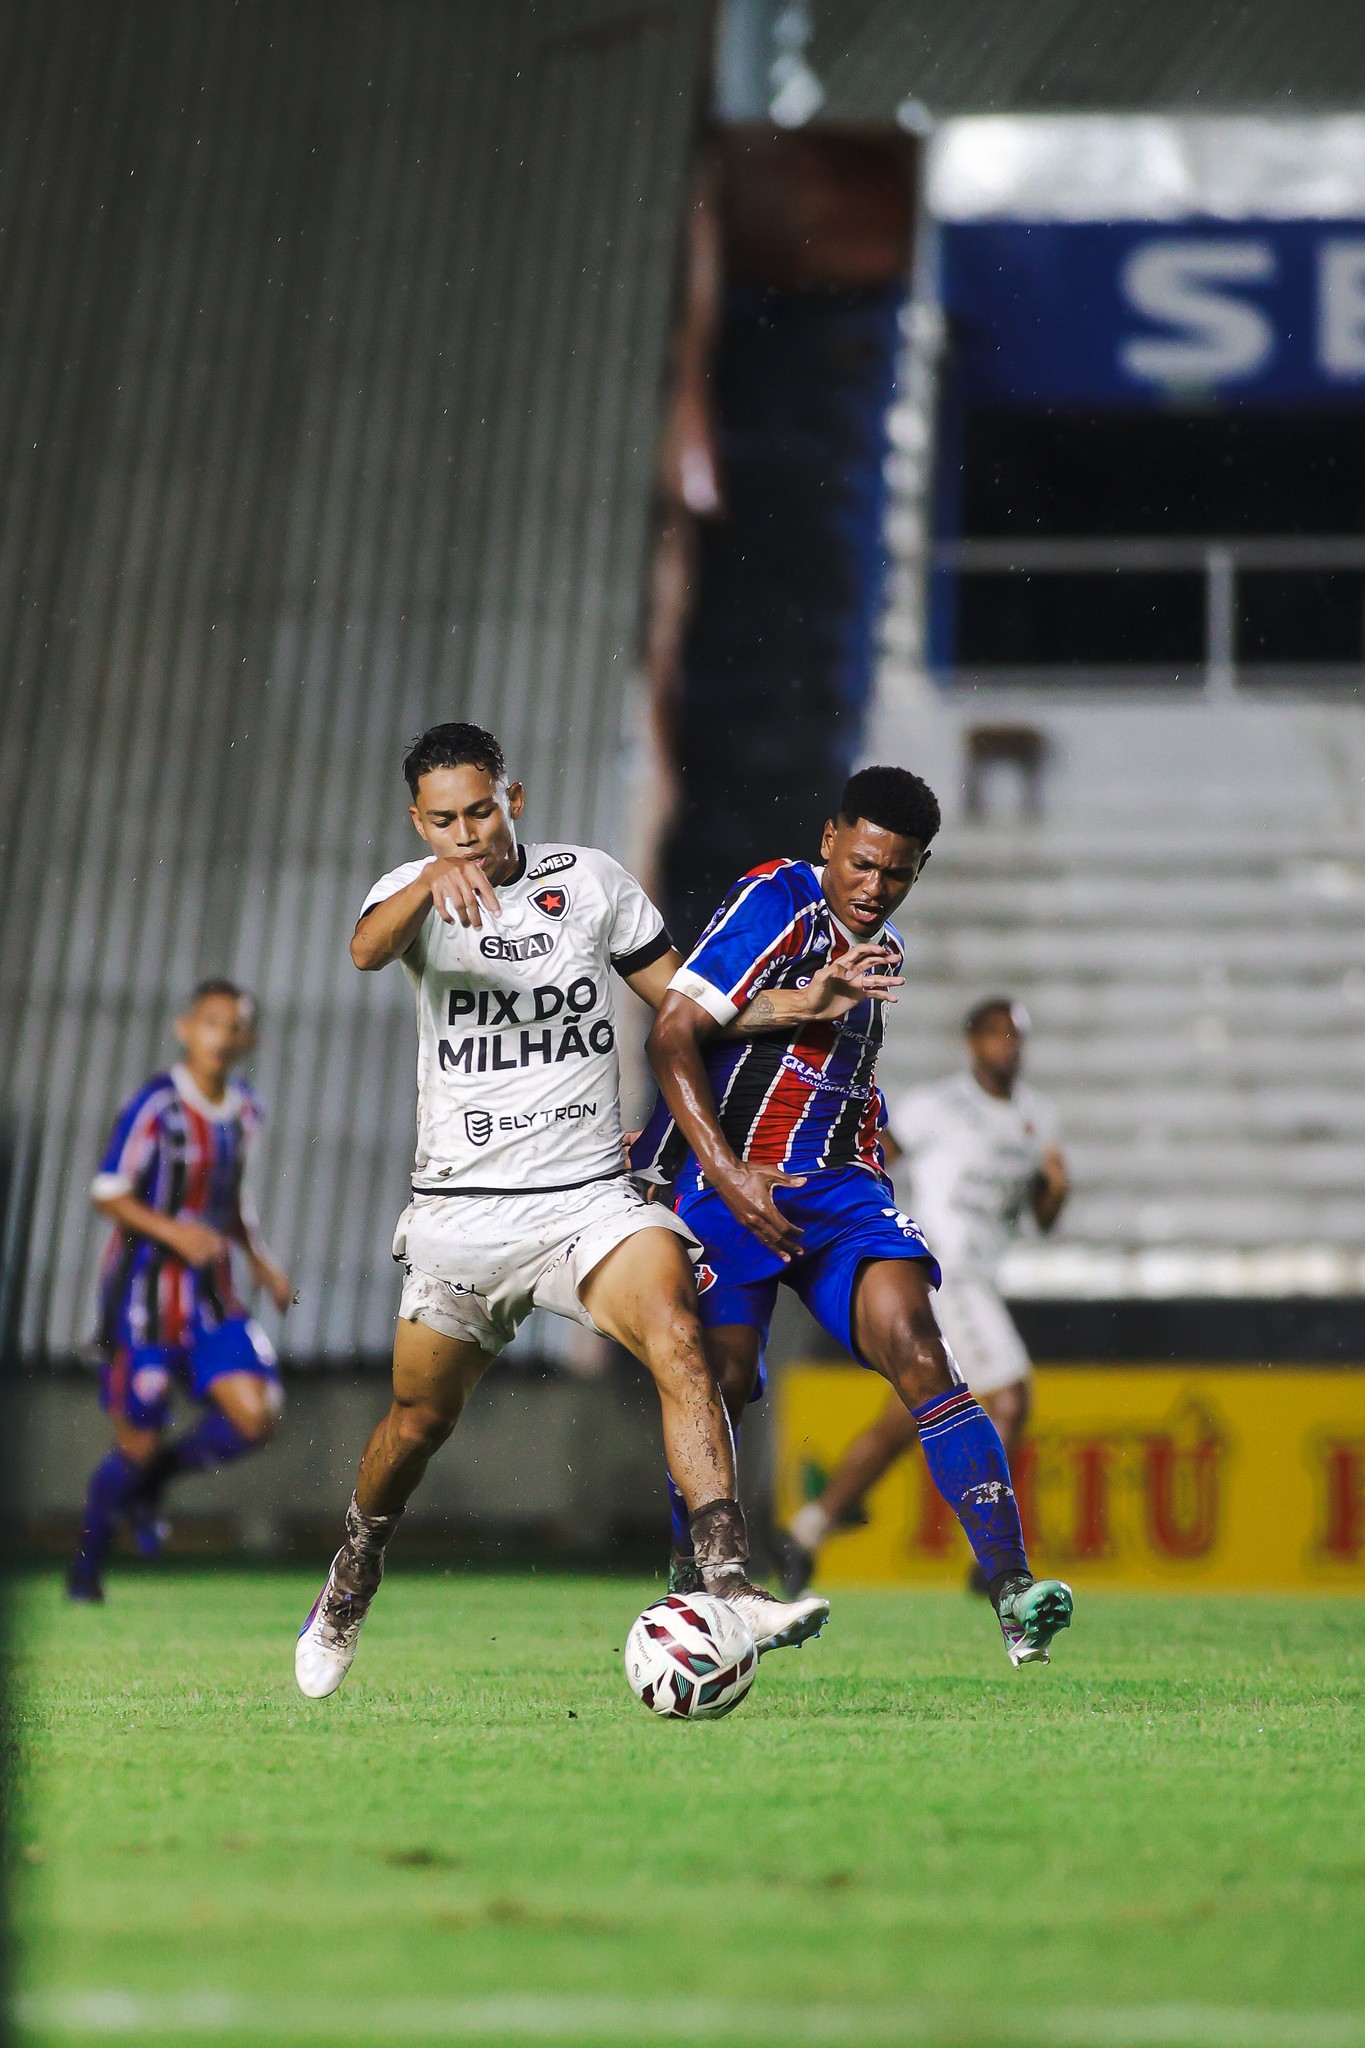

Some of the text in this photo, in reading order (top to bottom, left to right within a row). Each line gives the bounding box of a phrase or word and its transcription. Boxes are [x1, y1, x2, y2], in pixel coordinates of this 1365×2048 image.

[448, 977, 597, 1026] PIX DO
[438, 1014, 614, 1073] MILHÃO
[500, 1103, 597, 1130] ELYTRON
